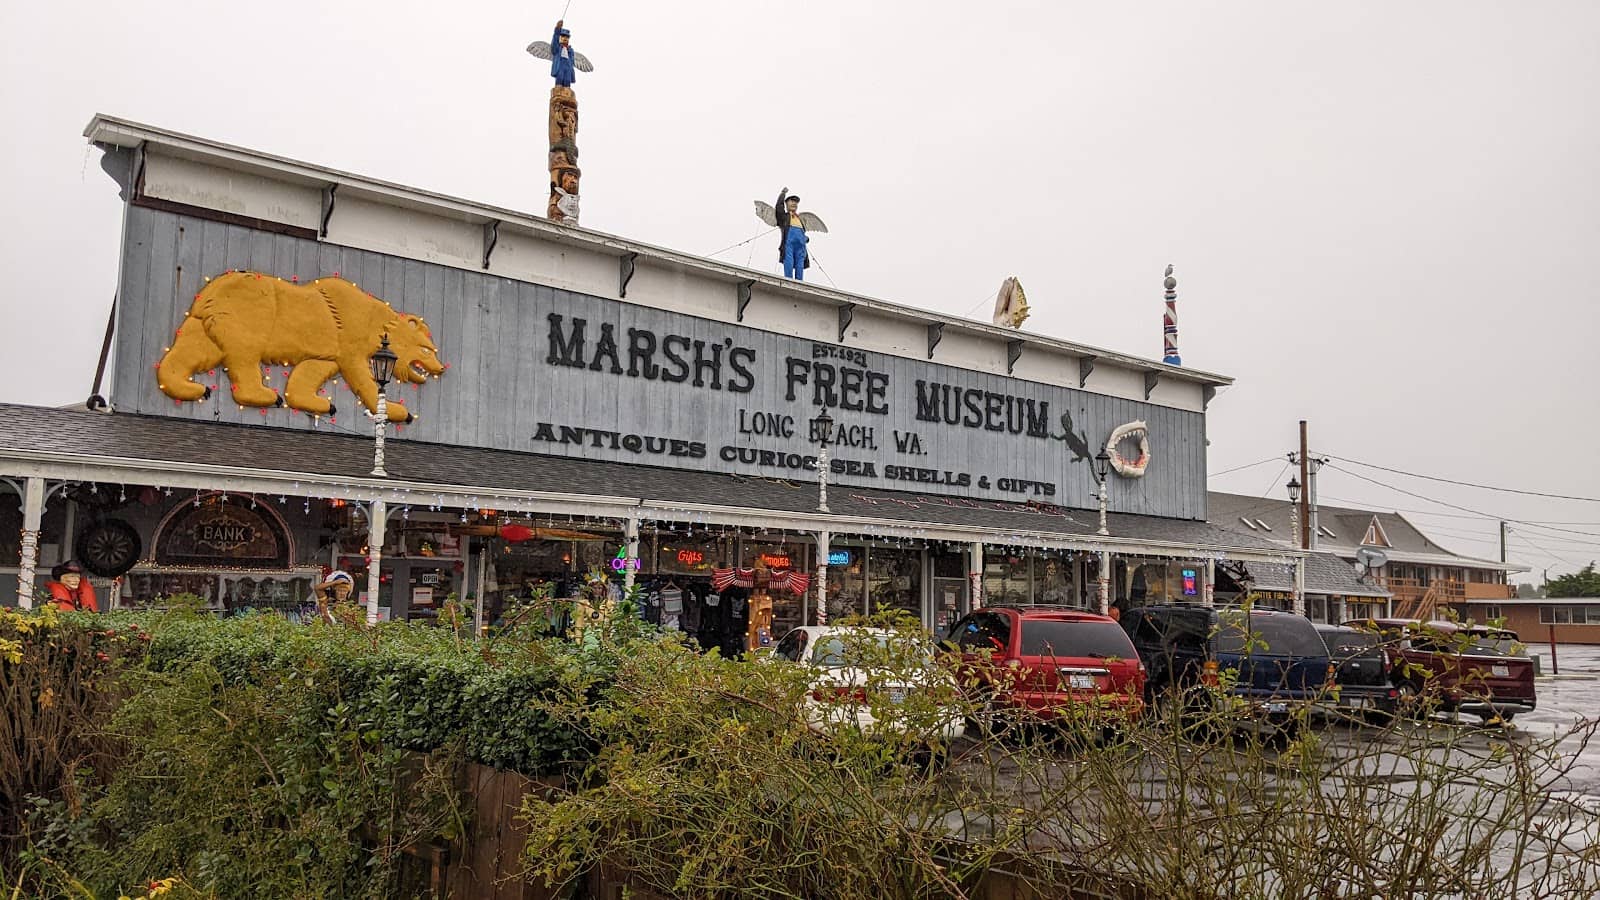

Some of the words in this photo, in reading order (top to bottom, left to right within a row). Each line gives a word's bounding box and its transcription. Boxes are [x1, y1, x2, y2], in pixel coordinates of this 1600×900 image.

[813, 344, 867, 367] EST.1921
[546, 313, 756, 393] MARSH'S
[785, 356, 889, 415] FREE
[915, 379, 1050, 439] MUSEUM
[739, 409, 794, 438] LONG
[893, 430, 927, 455] WA.
[531, 422, 707, 459] ANTIQUES
[830, 458, 878, 478] SEA
[885, 464, 971, 487] SHELLS
[978, 476, 991, 489] &
[997, 477, 1056, 495] GIFTS
[203, 526, 245, 541] BANK
[424, 575, 438, 583] OPEN
